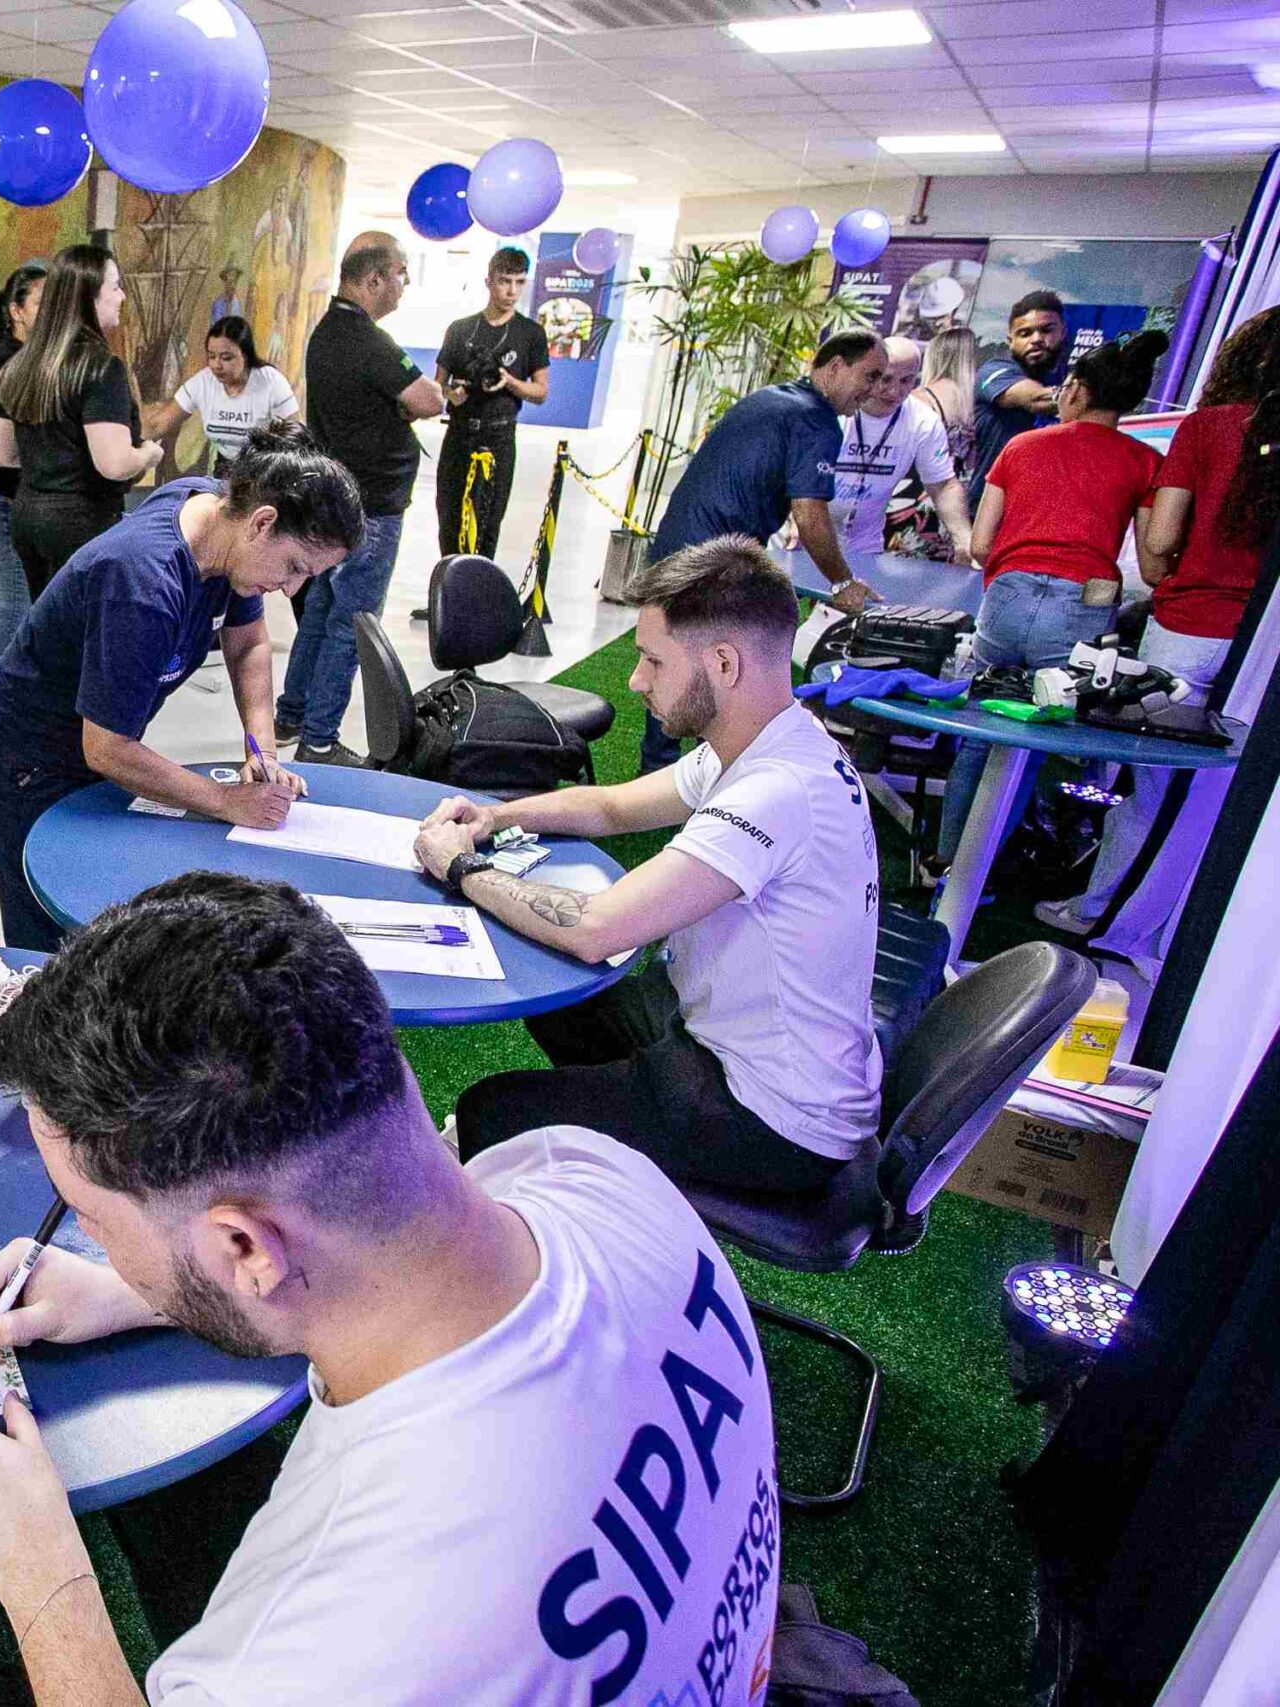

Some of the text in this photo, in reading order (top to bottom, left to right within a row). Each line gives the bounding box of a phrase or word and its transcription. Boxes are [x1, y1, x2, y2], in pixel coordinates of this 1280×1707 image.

[843, 271, 880, 284] SIPAT
[1074, 335, 1104, 347] MEIO
[218, 410, 249, 423] SIPAT
[848, 443, 893, 459] SIPAT
[1022, 1120, 1066, 1141] VOLK
[538, 1249, 755, 1707] SIPAT
[697, 1468, 770, 1696] PORTOS
